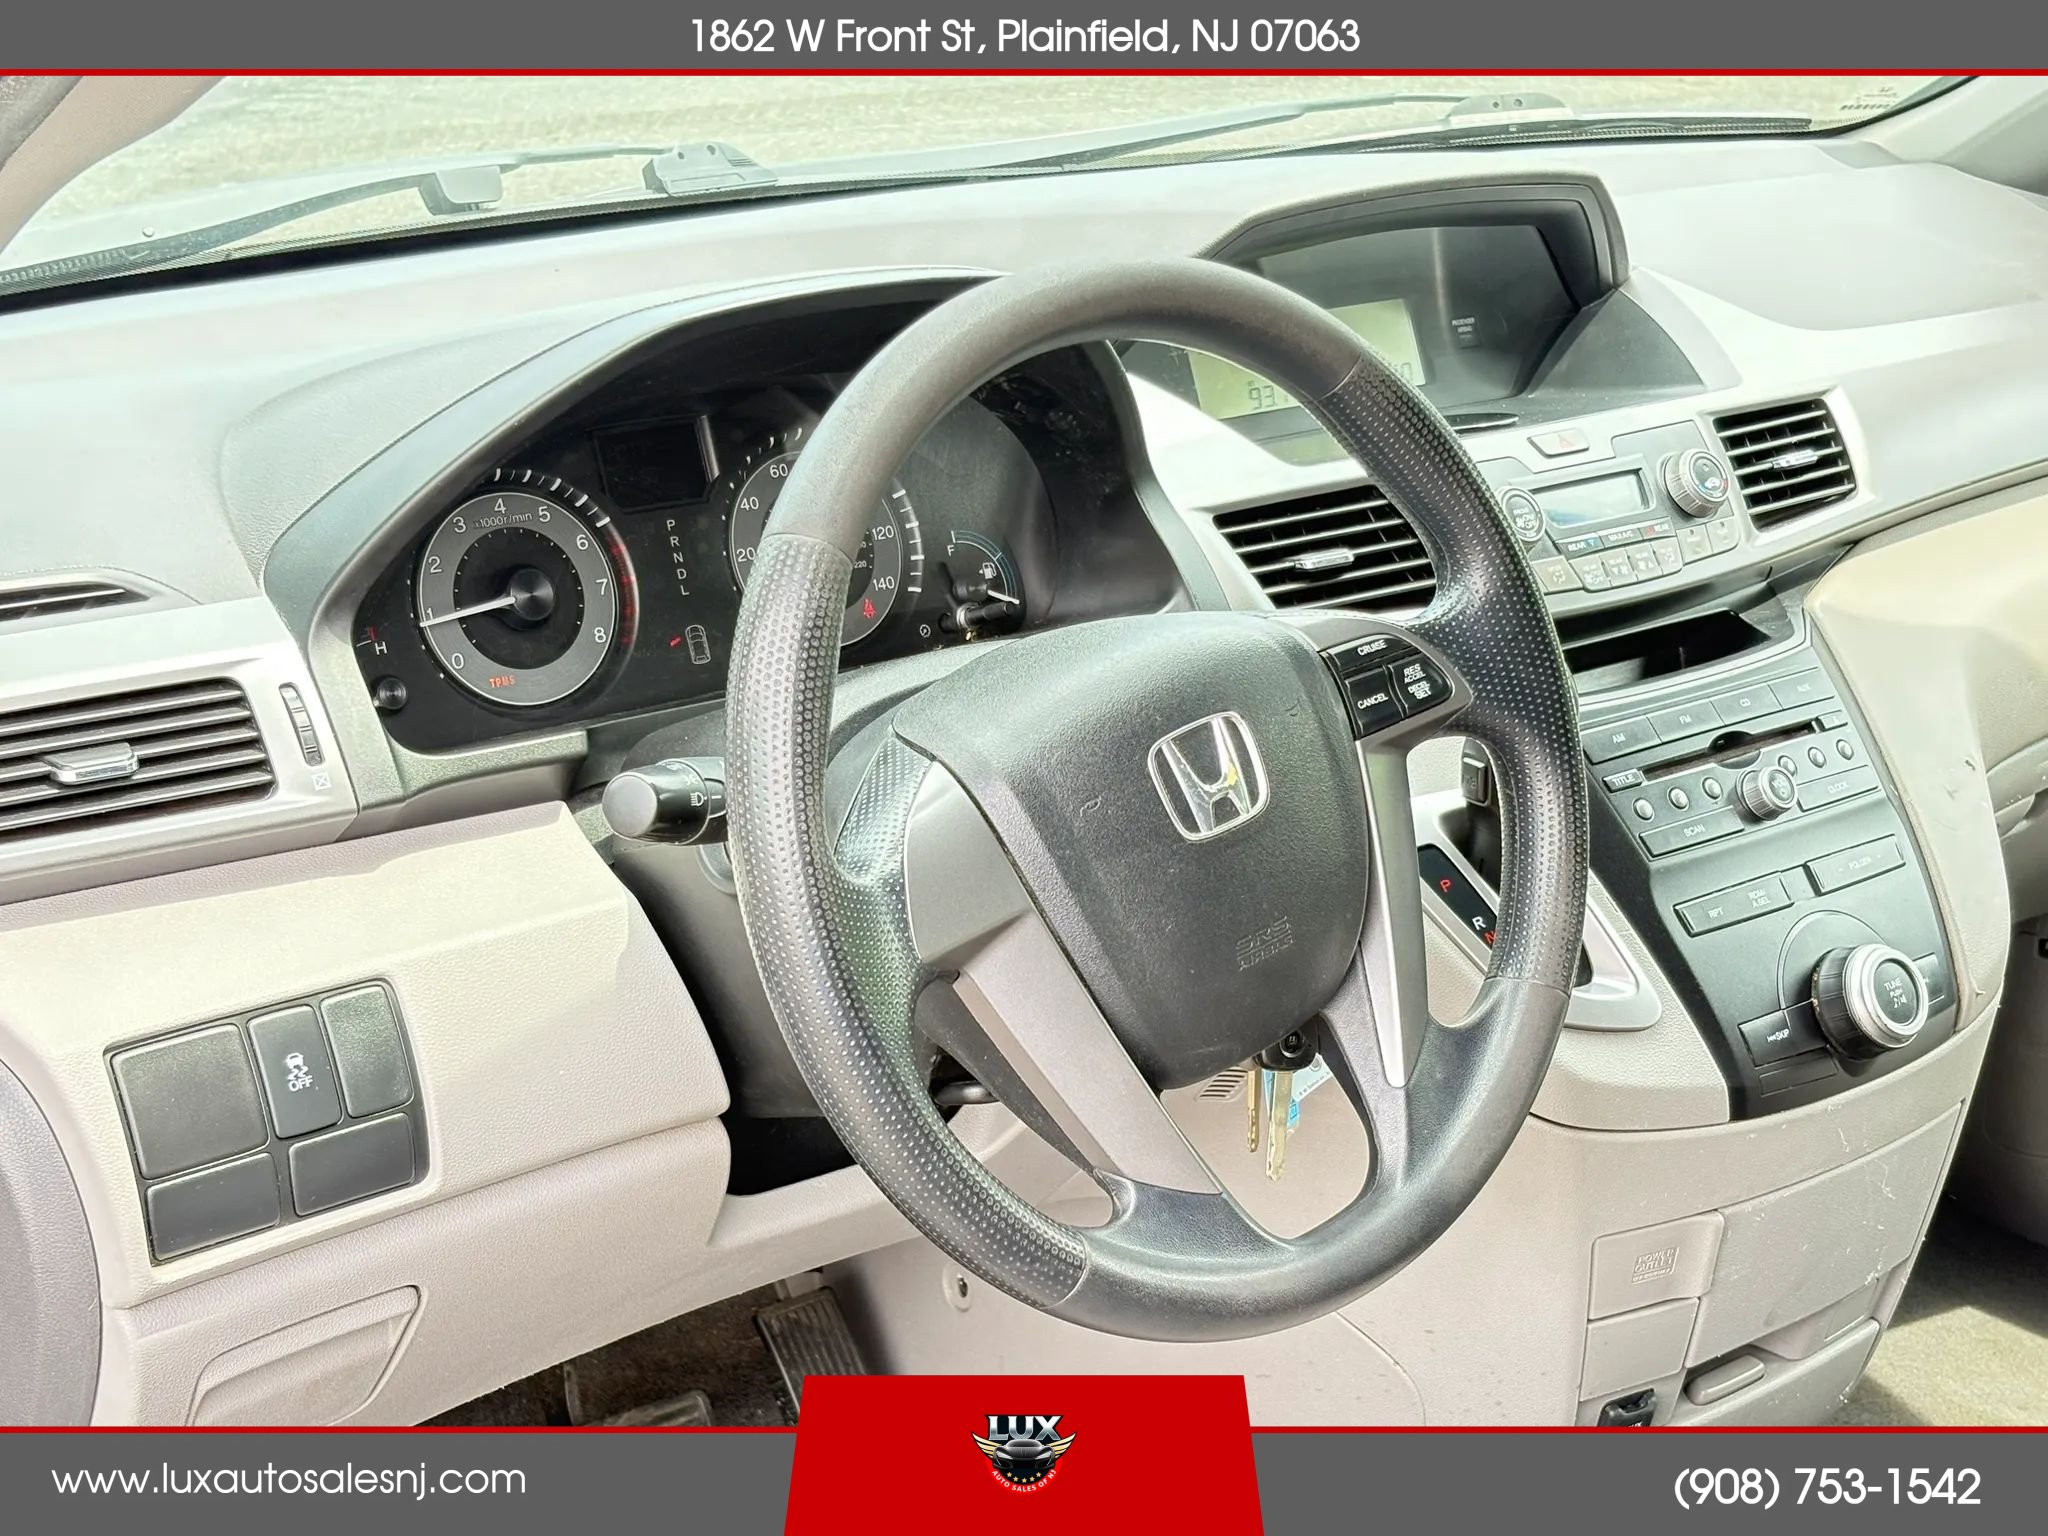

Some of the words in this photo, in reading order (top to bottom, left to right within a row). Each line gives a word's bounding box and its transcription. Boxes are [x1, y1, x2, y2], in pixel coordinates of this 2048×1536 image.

[769, 464, 789, 478] 60
[494, 498, 507, 513] 4
[741, 496, 759, 511] 40
[538, 506, 551, 523] 5
[453, 517, 466, 533] 3
[666, 519, 675, 531] P
[872, 525, 894, 540] 120
[576, 535, 589, 550] 6
[670, 536, 680, 547] R
[736, 548, 757, 562] 20
[947, 544, 955, 556] F
[428, 556, 442, 573] 2
[673, 552, 684, 563] N
[676, 568, 687, 580] D
[595, 578, 608, 595] 7
[680, 585, 690, 596] L
[873, 576, 895, 591] 140
[594, 627, 606, 643] 8
[374, 641, 388, 655] H
[1357, 639, 1388, 656] CRUISE
[451, 653, 465, 670] 0
[1404, 664, 1421, 676] RES
[1404, 672, 1426, 684] ACCEL
[1408, 681, 1430, 694] DECEL
[1414, 688, 1431, 700] SET
[1357, 693, 1388, 709] CANCEL
[1680, 714, 1691, 725] FM
[1612, 733, 1625, 744] AM
[1611, 774, 1636, 787] TITLE
[1684, 824, 1706, 837] SCAN
[1439, 879, 1451, 893] P
[1708, 907, 1724, 919] RPT
[1472, 916, 1486, 930] R
[1884, 977, 1902, 991] TUNE
[288, 1075, 313, 1092] OFF
[1638, 1249, 1675, 1264] POWER
[1634, 1257, 1674, 1273] OUTLET
